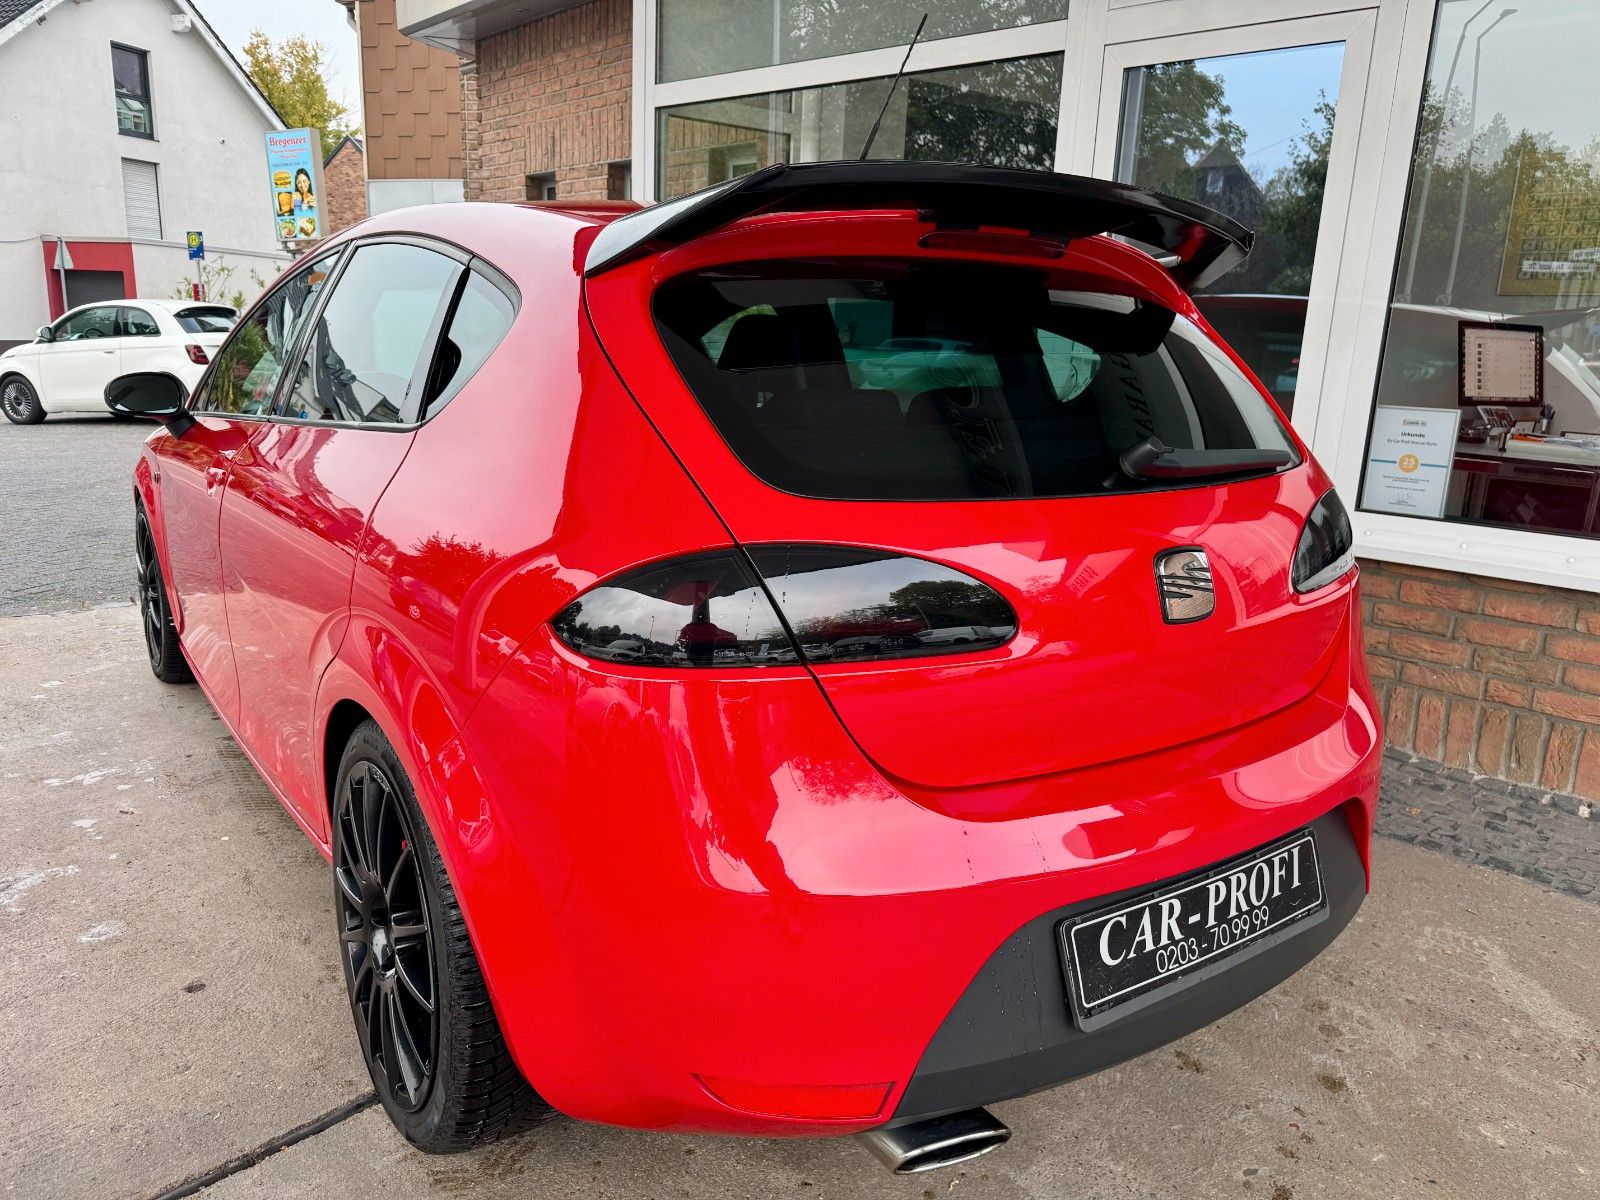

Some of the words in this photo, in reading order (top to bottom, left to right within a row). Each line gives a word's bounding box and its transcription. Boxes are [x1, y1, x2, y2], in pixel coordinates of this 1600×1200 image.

[1100, 846, 1302, 966] CAR-PROFI
[1156, 938, 1199, 973] 0203
[1210, 924, 1229, 950] 70
[1232, 915, 1250, 940] 99
[1252, 906, 1269, 931] 99
